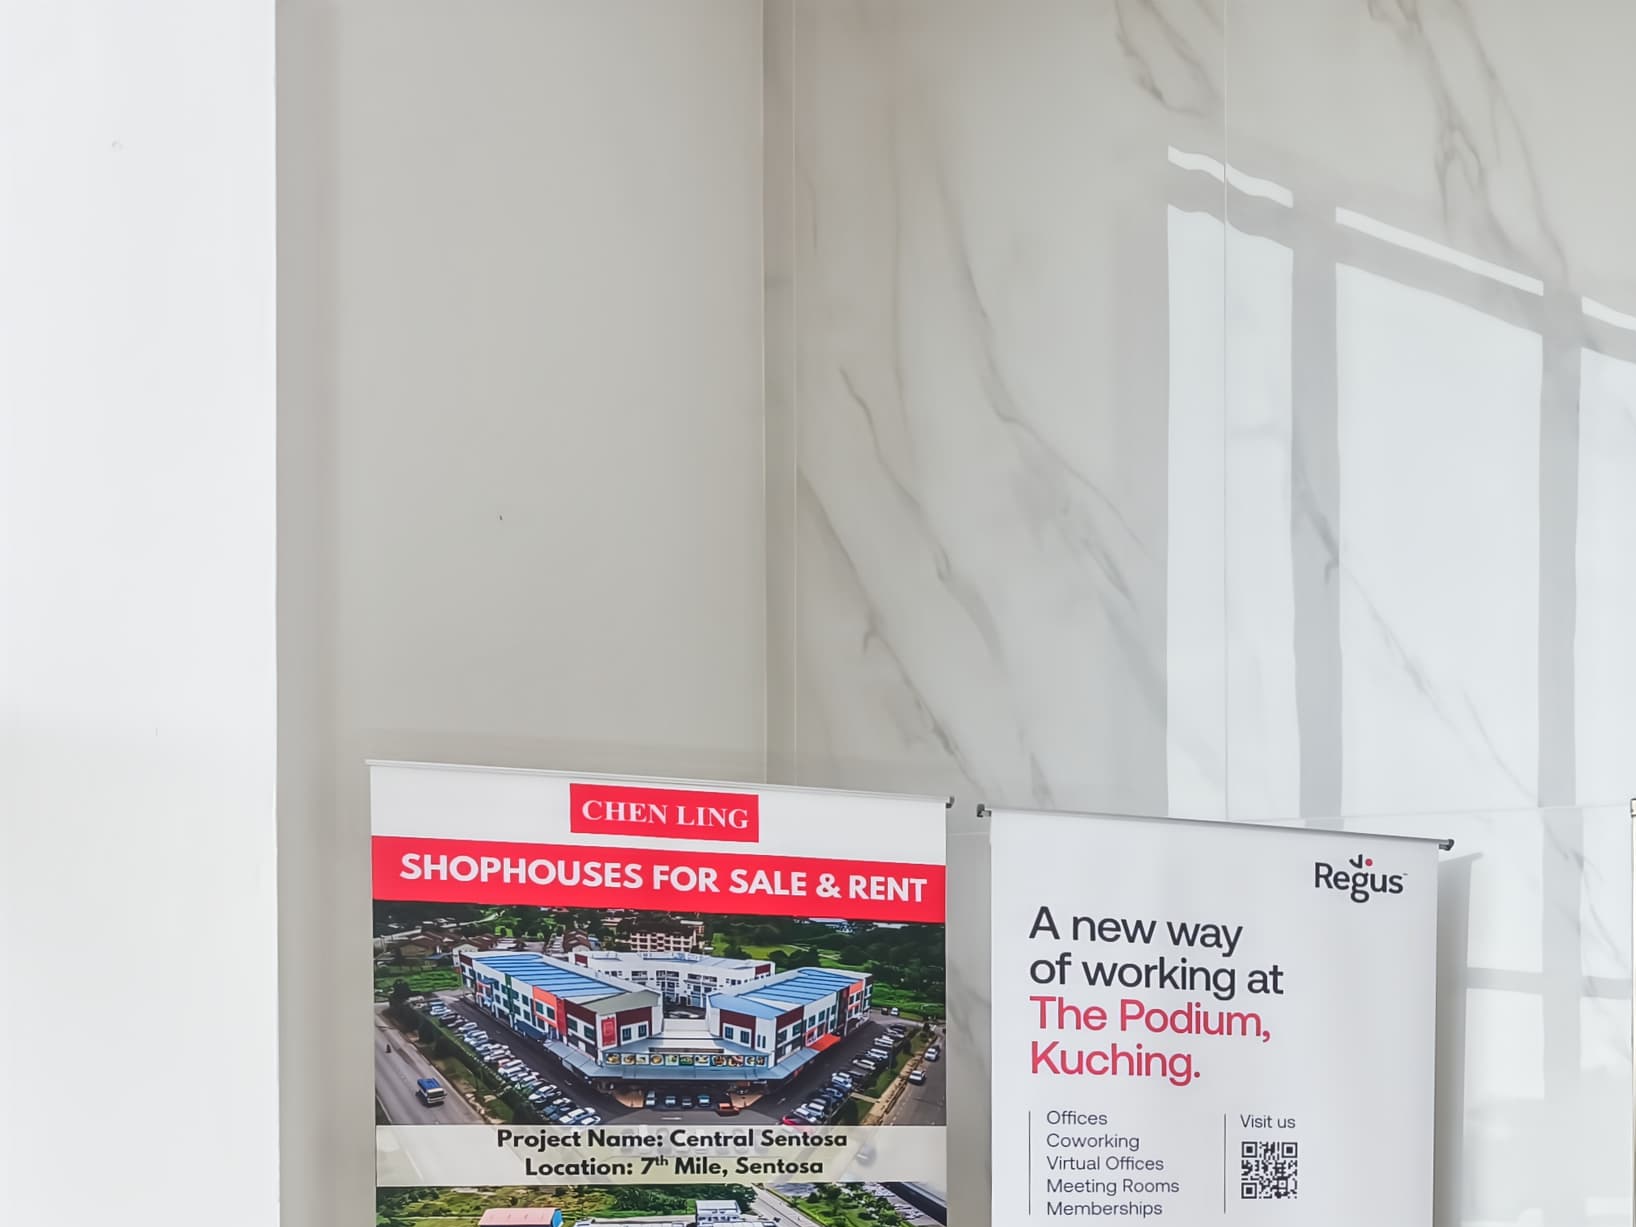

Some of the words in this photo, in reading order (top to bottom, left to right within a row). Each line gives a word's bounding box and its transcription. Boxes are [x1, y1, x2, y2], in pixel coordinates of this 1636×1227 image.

[581, 799, 668, 826] CHEN
[677, 805, 749, 829] LING
[400, 853, 643, 889] SHOPHOUSES
[653, 865, 720, 893] FOR
[728, 868, 806, 897] SALE
[816, 873, 842, 898] &
[848, 875, 928, 903] RENT
[1314, 855, 1404, 903] Regus
[1029, 906, 1060, 940] A
[1072, 915, 1157, 944] new
[1166, 921, 1243, 957] way
[1029, 952, 1072, 985] of
[1082, 957, 1236, 1001] working
[1247, 964, 1284, 996] at
[1029, 995, 1108, 1031] The
[1120, 998, 1271, 1043] Podium,
[1031, 1041, 1201, 1087] Kuching.
[1046, 1110, 1108, 1126] Offices
[1240, 1114, 1273, 1129] Visit
[1277, 1117, 1296, 1129] us
[497, 1129, 581, 1150] Project
[587, 1129, 664, 1149] Name:
[669, 1128, 754, 1148] Central
[760, 1129, 848, 1148] Sentosa
[1046, 1133, 1140, 1152] Coworking
[525, 1157, 633, 1177] Location:
[640, 1155, 669, 1177] 7th
[674, 1156, 728, 1178] Mile,
[736, 1157, 823, 1176] Sentosa
[1046, 1156, 1101, 1171] Virtual
[1105, 1156, 1164, 1172] Offices
[1046, 1178, 1117, 1196] Meeting
[1122, 1179, 1180, 1194] Rooms
[1046, 1201, 1163, 1219] Memberships
